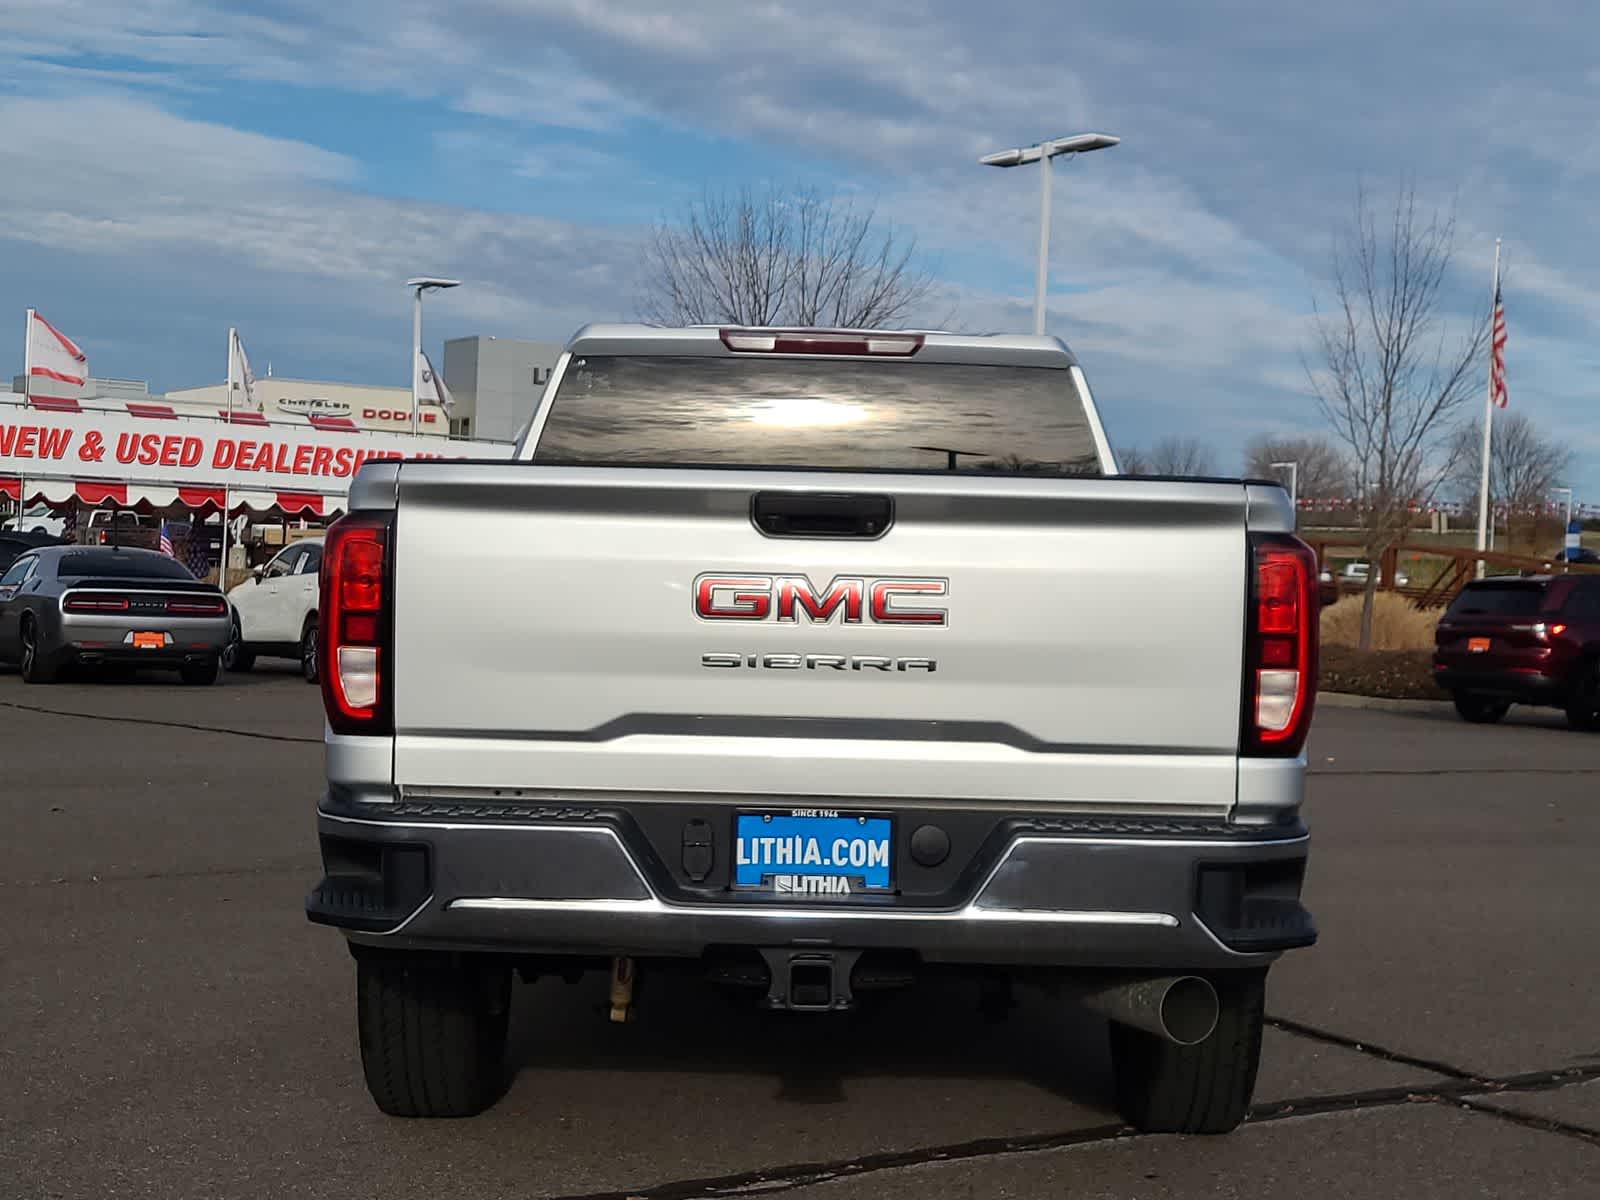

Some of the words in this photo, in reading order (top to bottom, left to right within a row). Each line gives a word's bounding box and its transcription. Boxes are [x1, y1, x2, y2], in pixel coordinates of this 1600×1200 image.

[0, 424, 72, 459] NEW
[78, 430, 106, 462] &
[115, 432, 204, 467] USED
[212, 439, 404, 477] DEALERS
[694, 572, 949, 628] GMC
[701, 652, 937, 673] SIERRA
[792, 809, 817, 817] SINCE
[736, 837, 889, 867] LITHIA.COM
[791, 875, 850, 893] LITHIA
